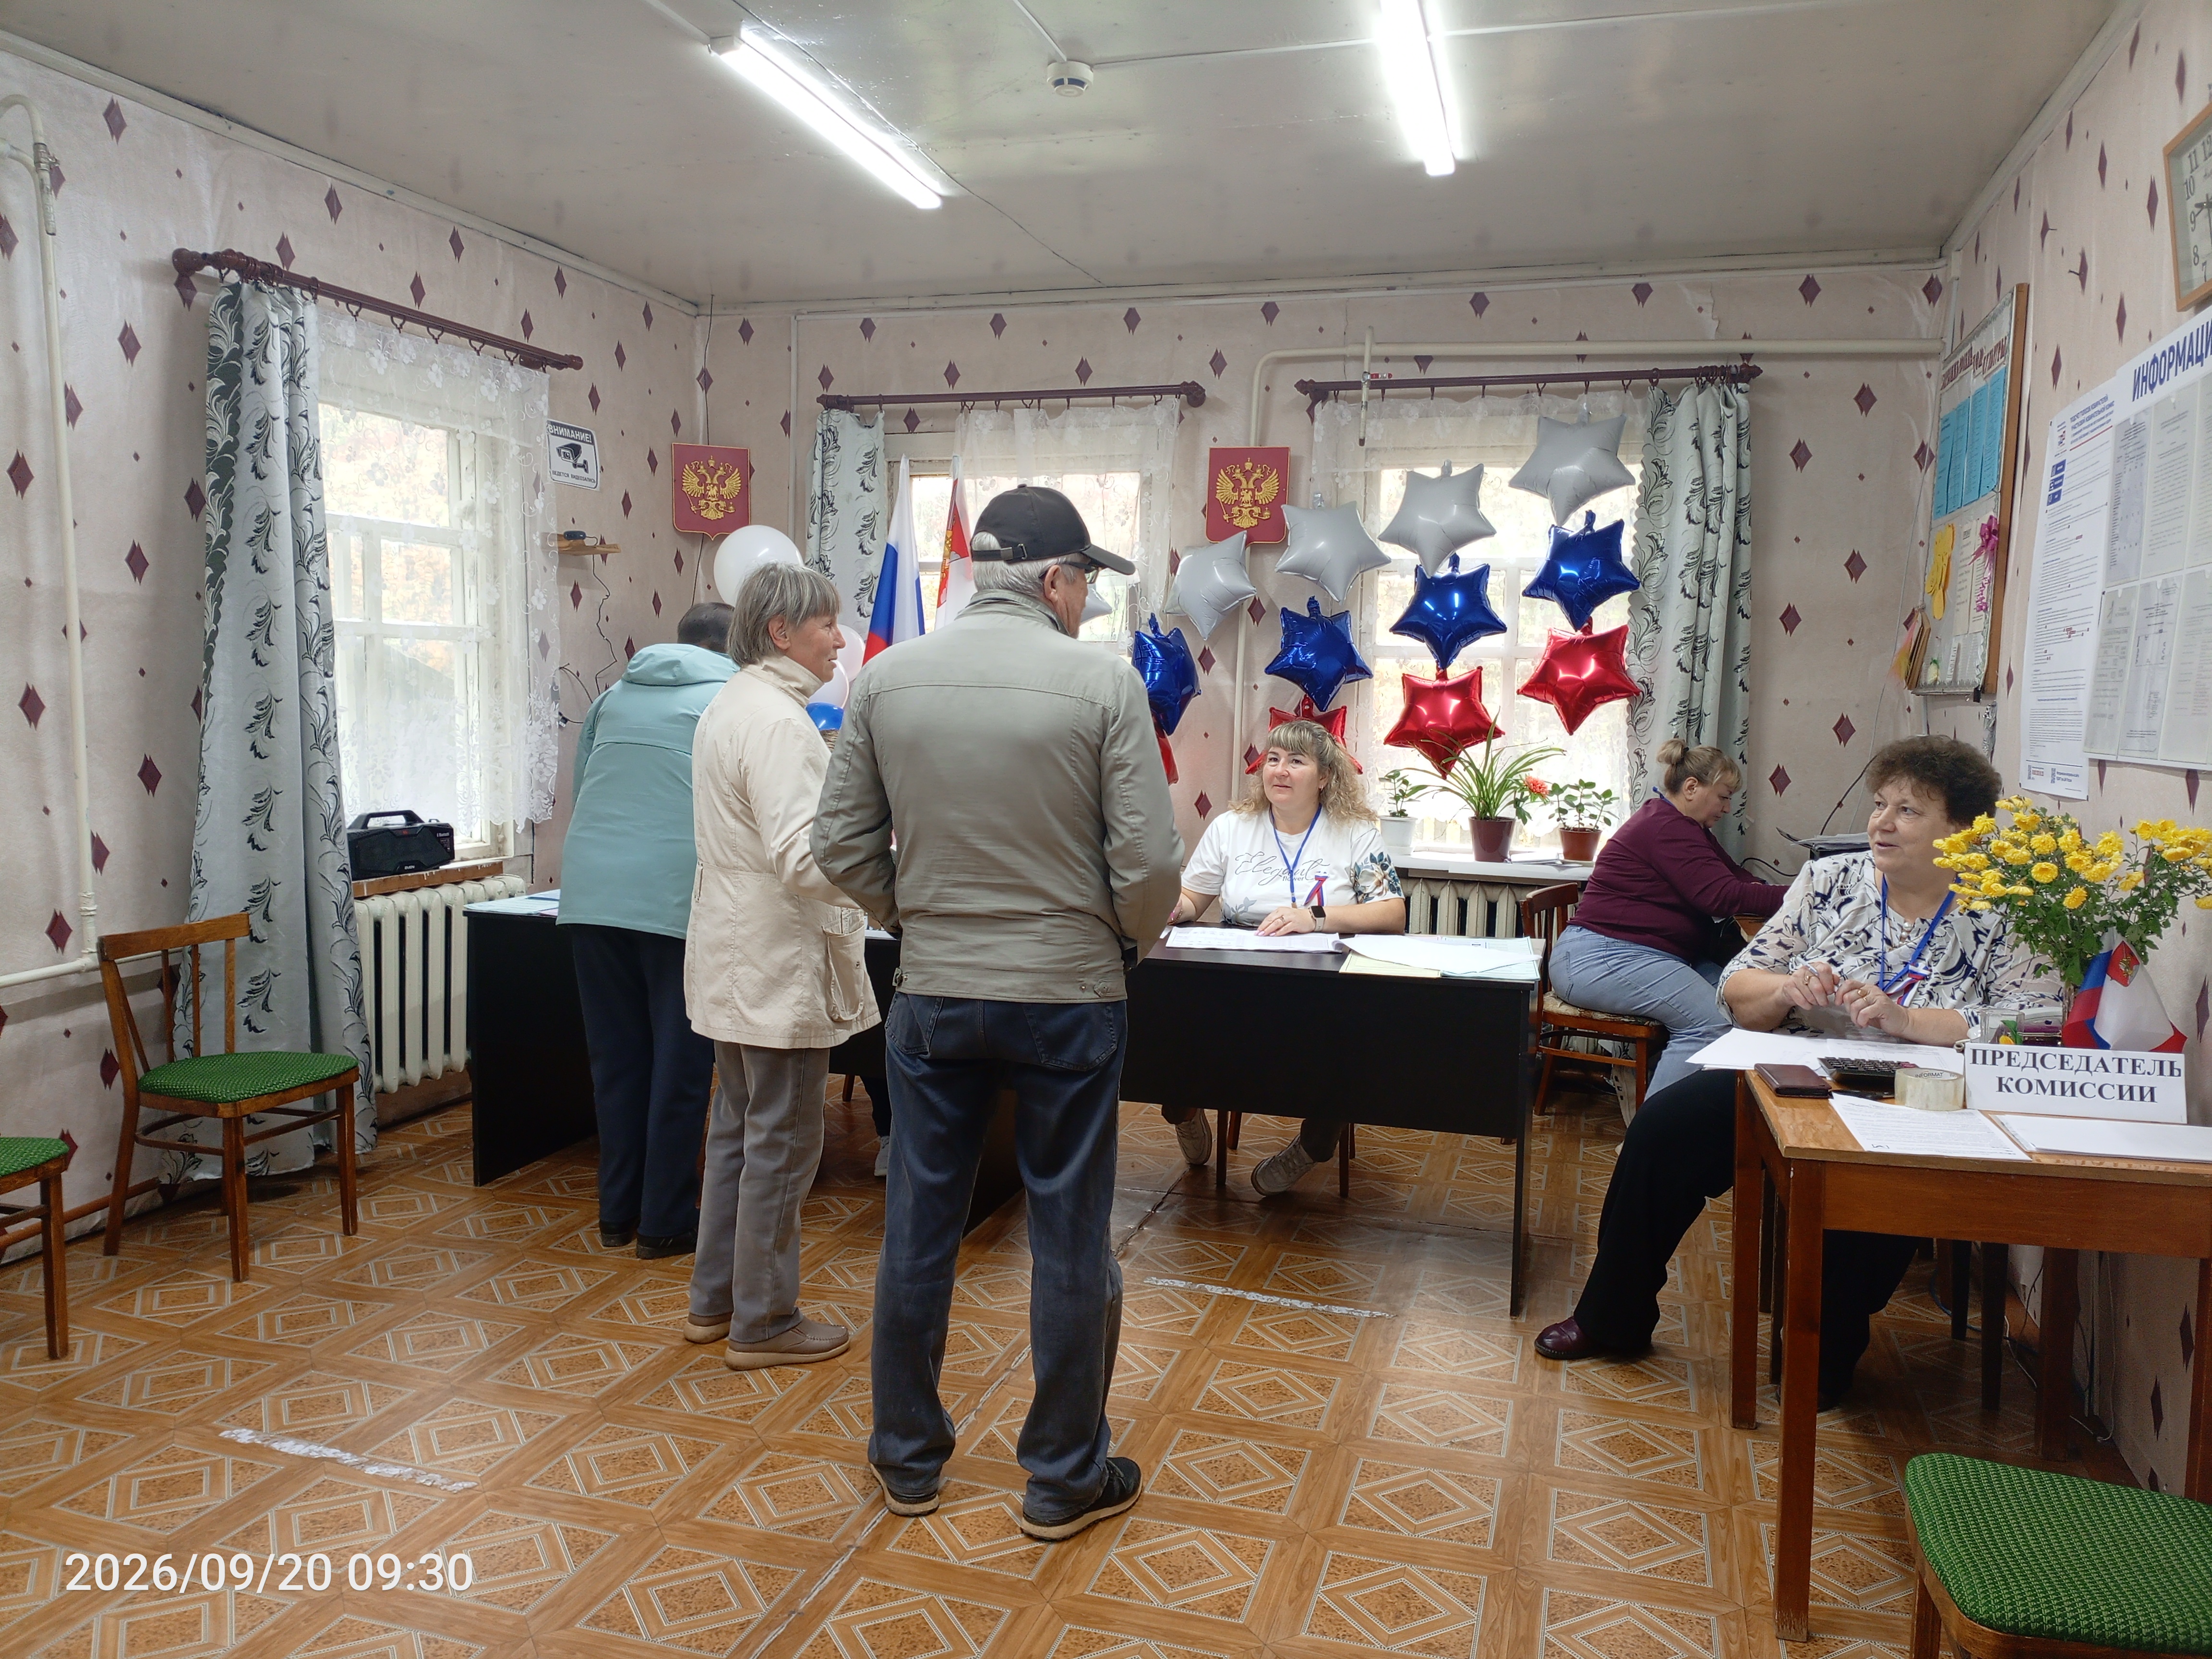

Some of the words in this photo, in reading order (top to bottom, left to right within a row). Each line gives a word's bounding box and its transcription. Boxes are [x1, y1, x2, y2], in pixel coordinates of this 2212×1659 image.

[2188, 149, 2199, 173] 11
[2184, 175, 2195, 200] 10
[2190, 210, 2196, 232] 9
[2193, 245, 2199, 266] 8
[2201, 261, 2207, 282] 7
[548, 424, 592, 443] ВНИМАНИЕ!
[552, 470, 569, 478] ВЕДЕТСЯ
[1970, 1048, 2182, 1077] ПРЕДСЕДАТЕЛЬ
[1996, 1076, 2157, 1103] КОМИССИИ
